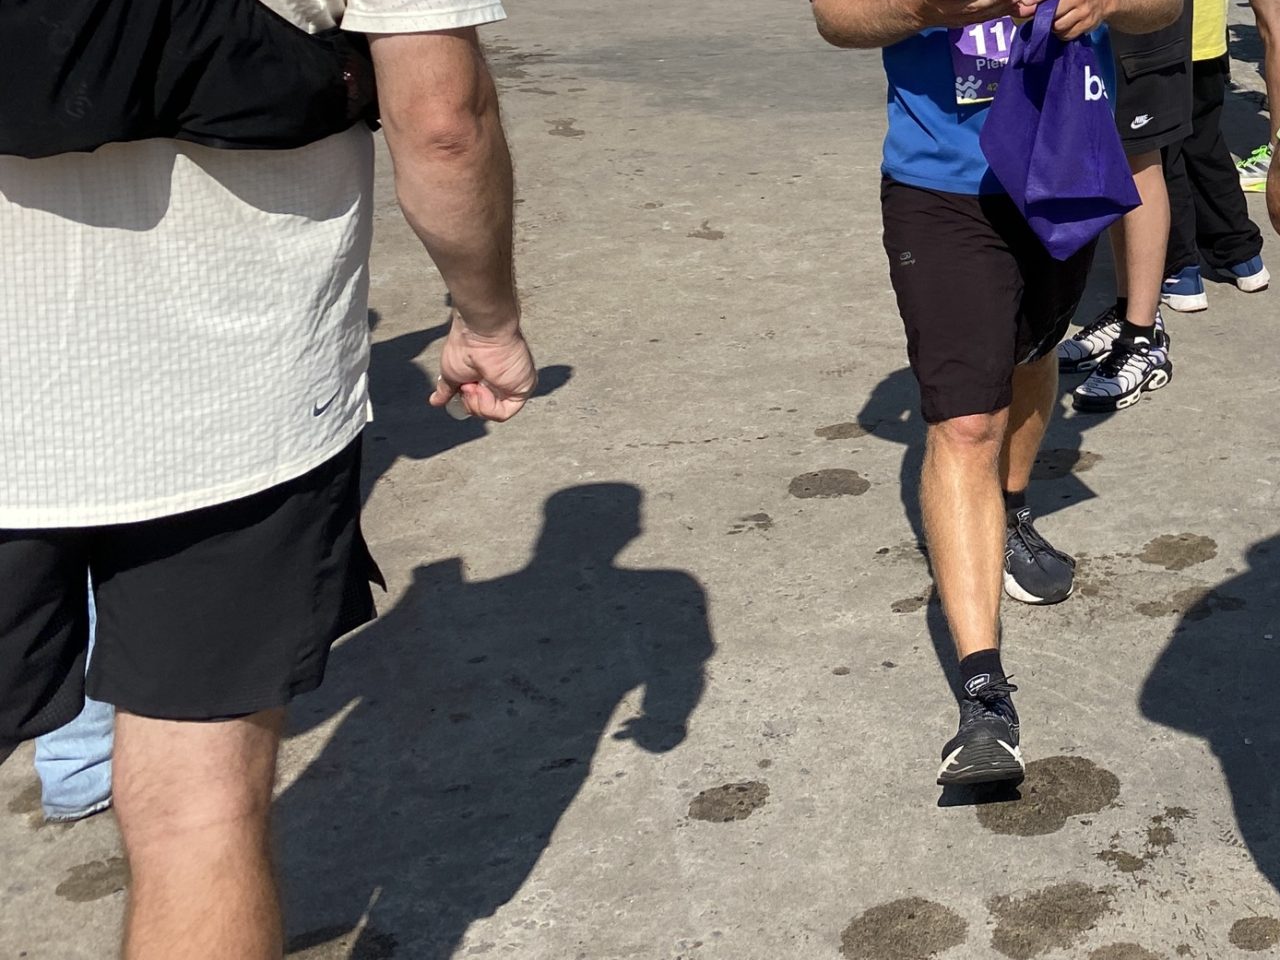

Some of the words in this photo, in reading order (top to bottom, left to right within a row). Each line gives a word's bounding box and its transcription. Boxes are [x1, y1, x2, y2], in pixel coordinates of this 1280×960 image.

[969, 21, 1017, 55] 11
[976, 58, 1009, 71] Pier
[1084, 65, 1109, 101] b
